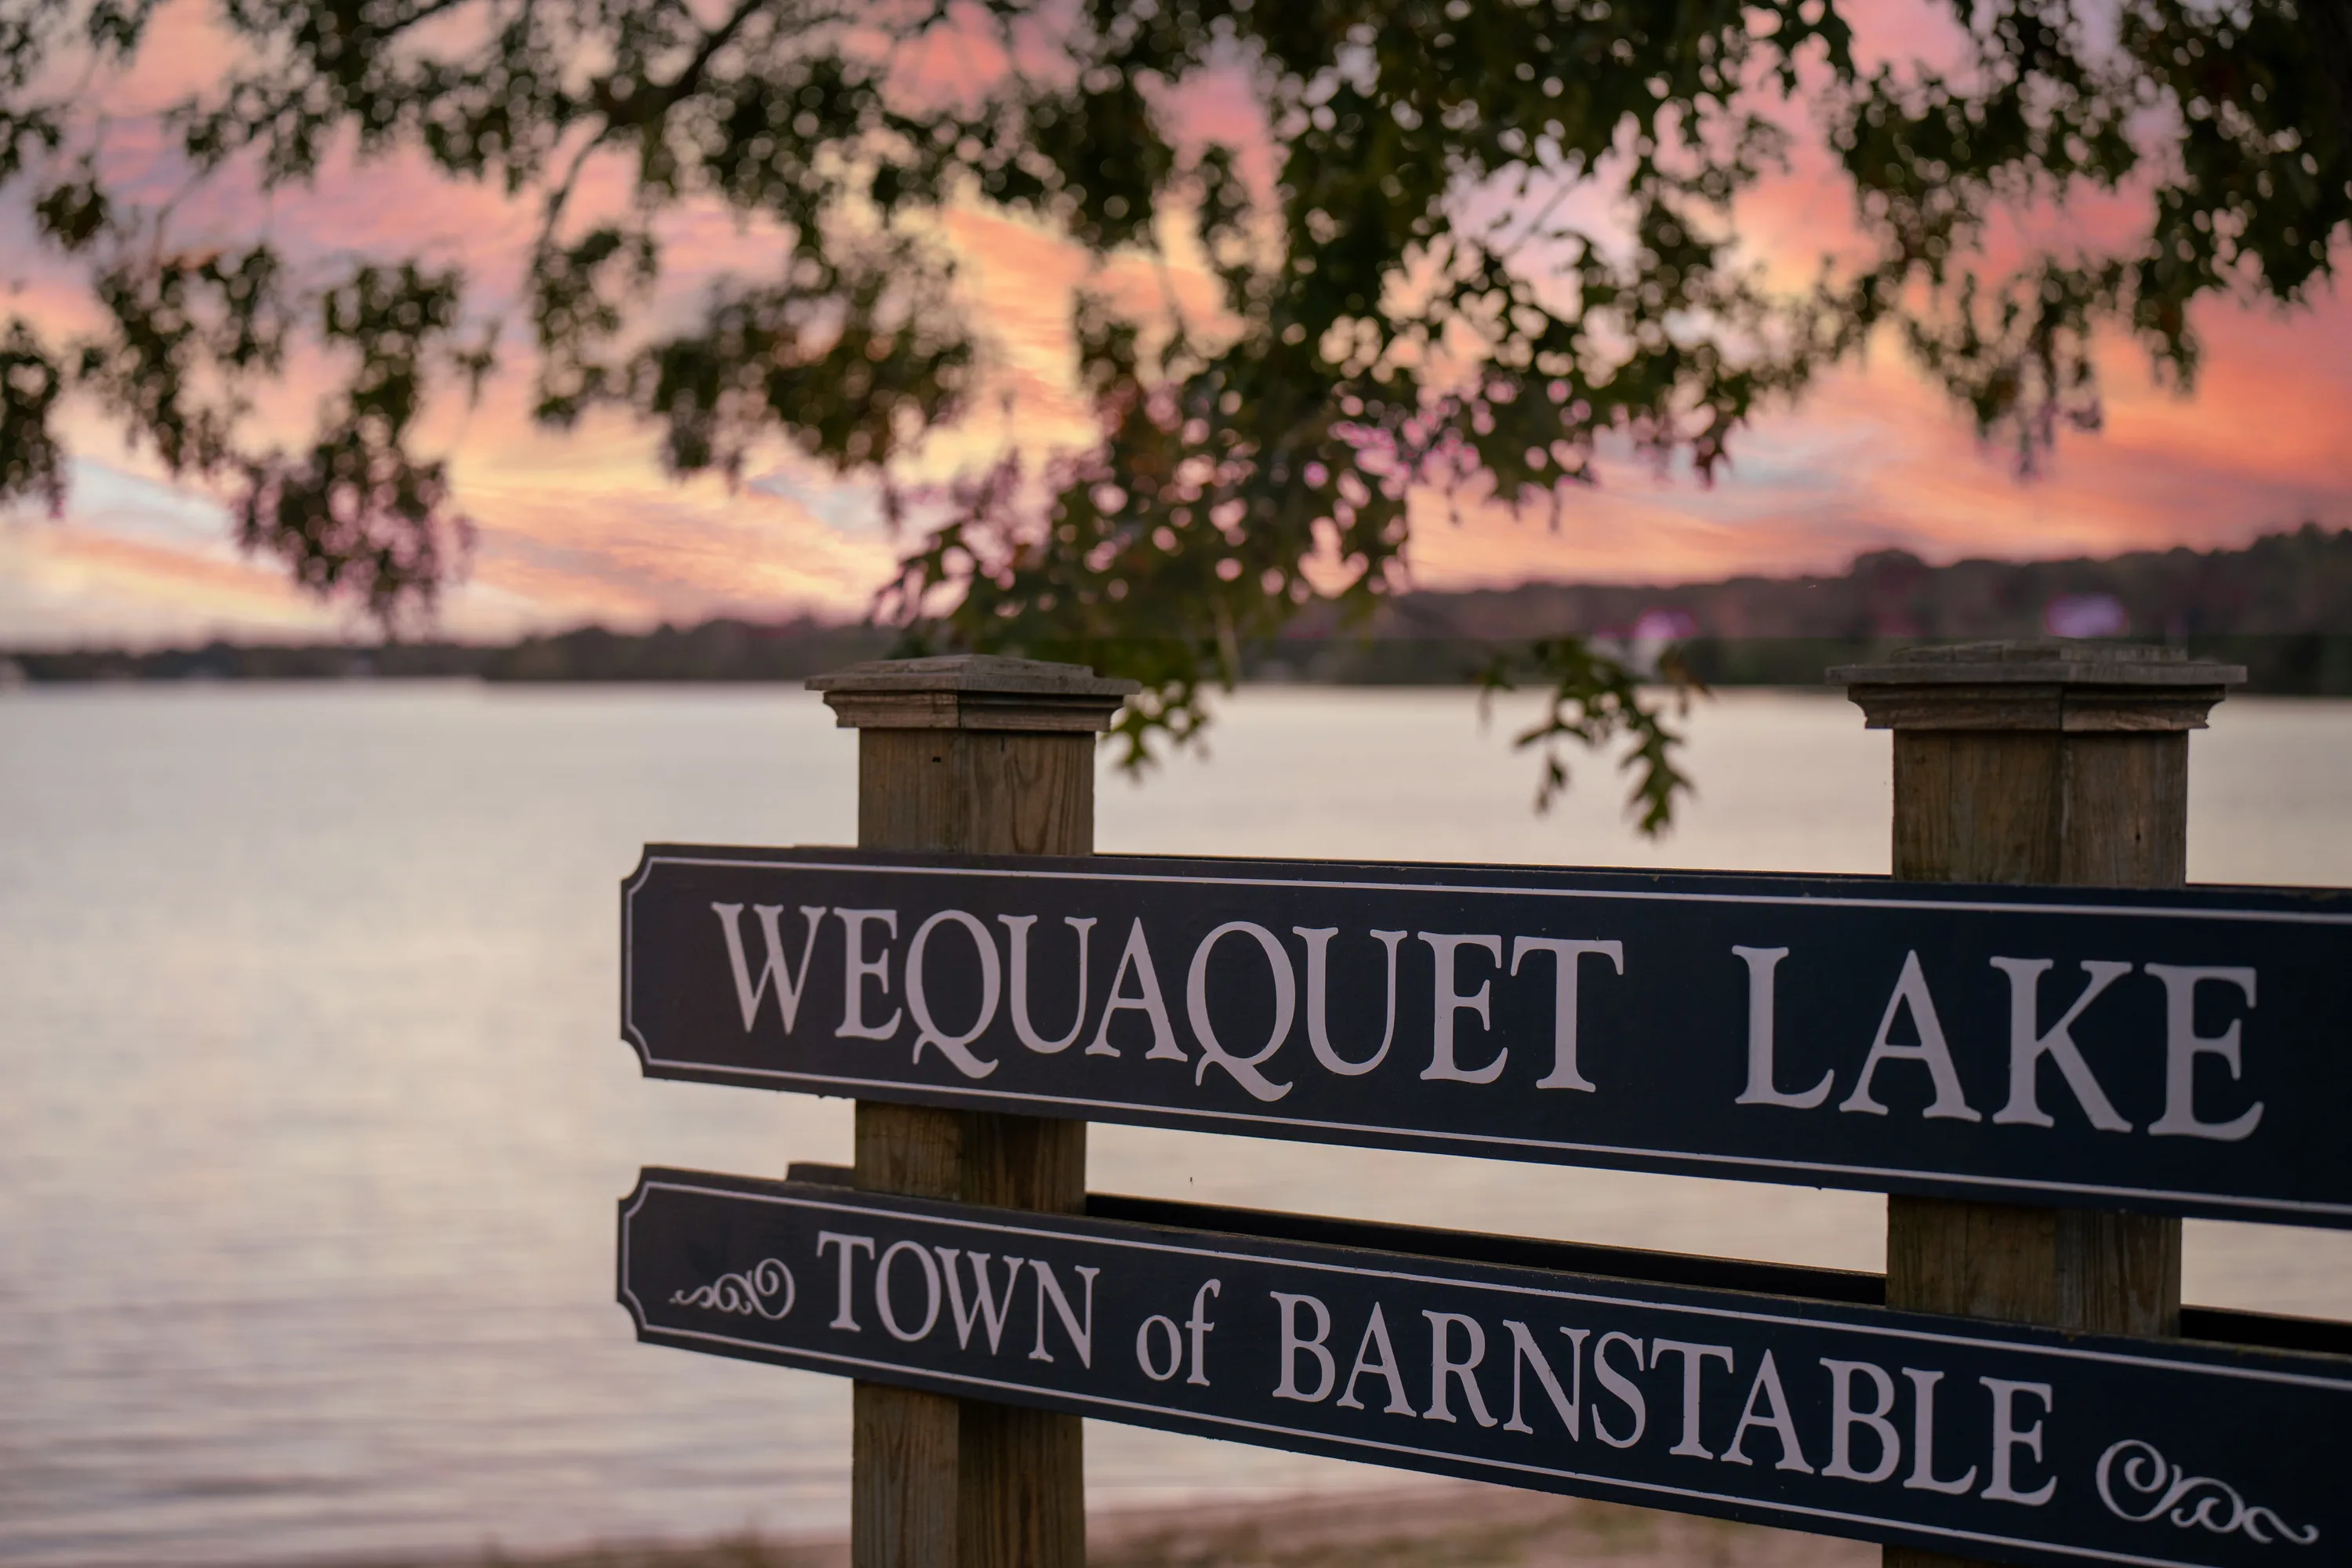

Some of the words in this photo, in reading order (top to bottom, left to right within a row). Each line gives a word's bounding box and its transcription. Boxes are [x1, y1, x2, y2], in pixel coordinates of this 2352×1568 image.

[710, 901, 1624, 1102] WEQUAQUET
[1731, 945, 2264, 1143] LAKE
[816, 1230, 1101, 1370] TOWN
[1135, 1278, 1221, 1387] of
[1269, 1290, 2057, 1506] BARNSTABLE
